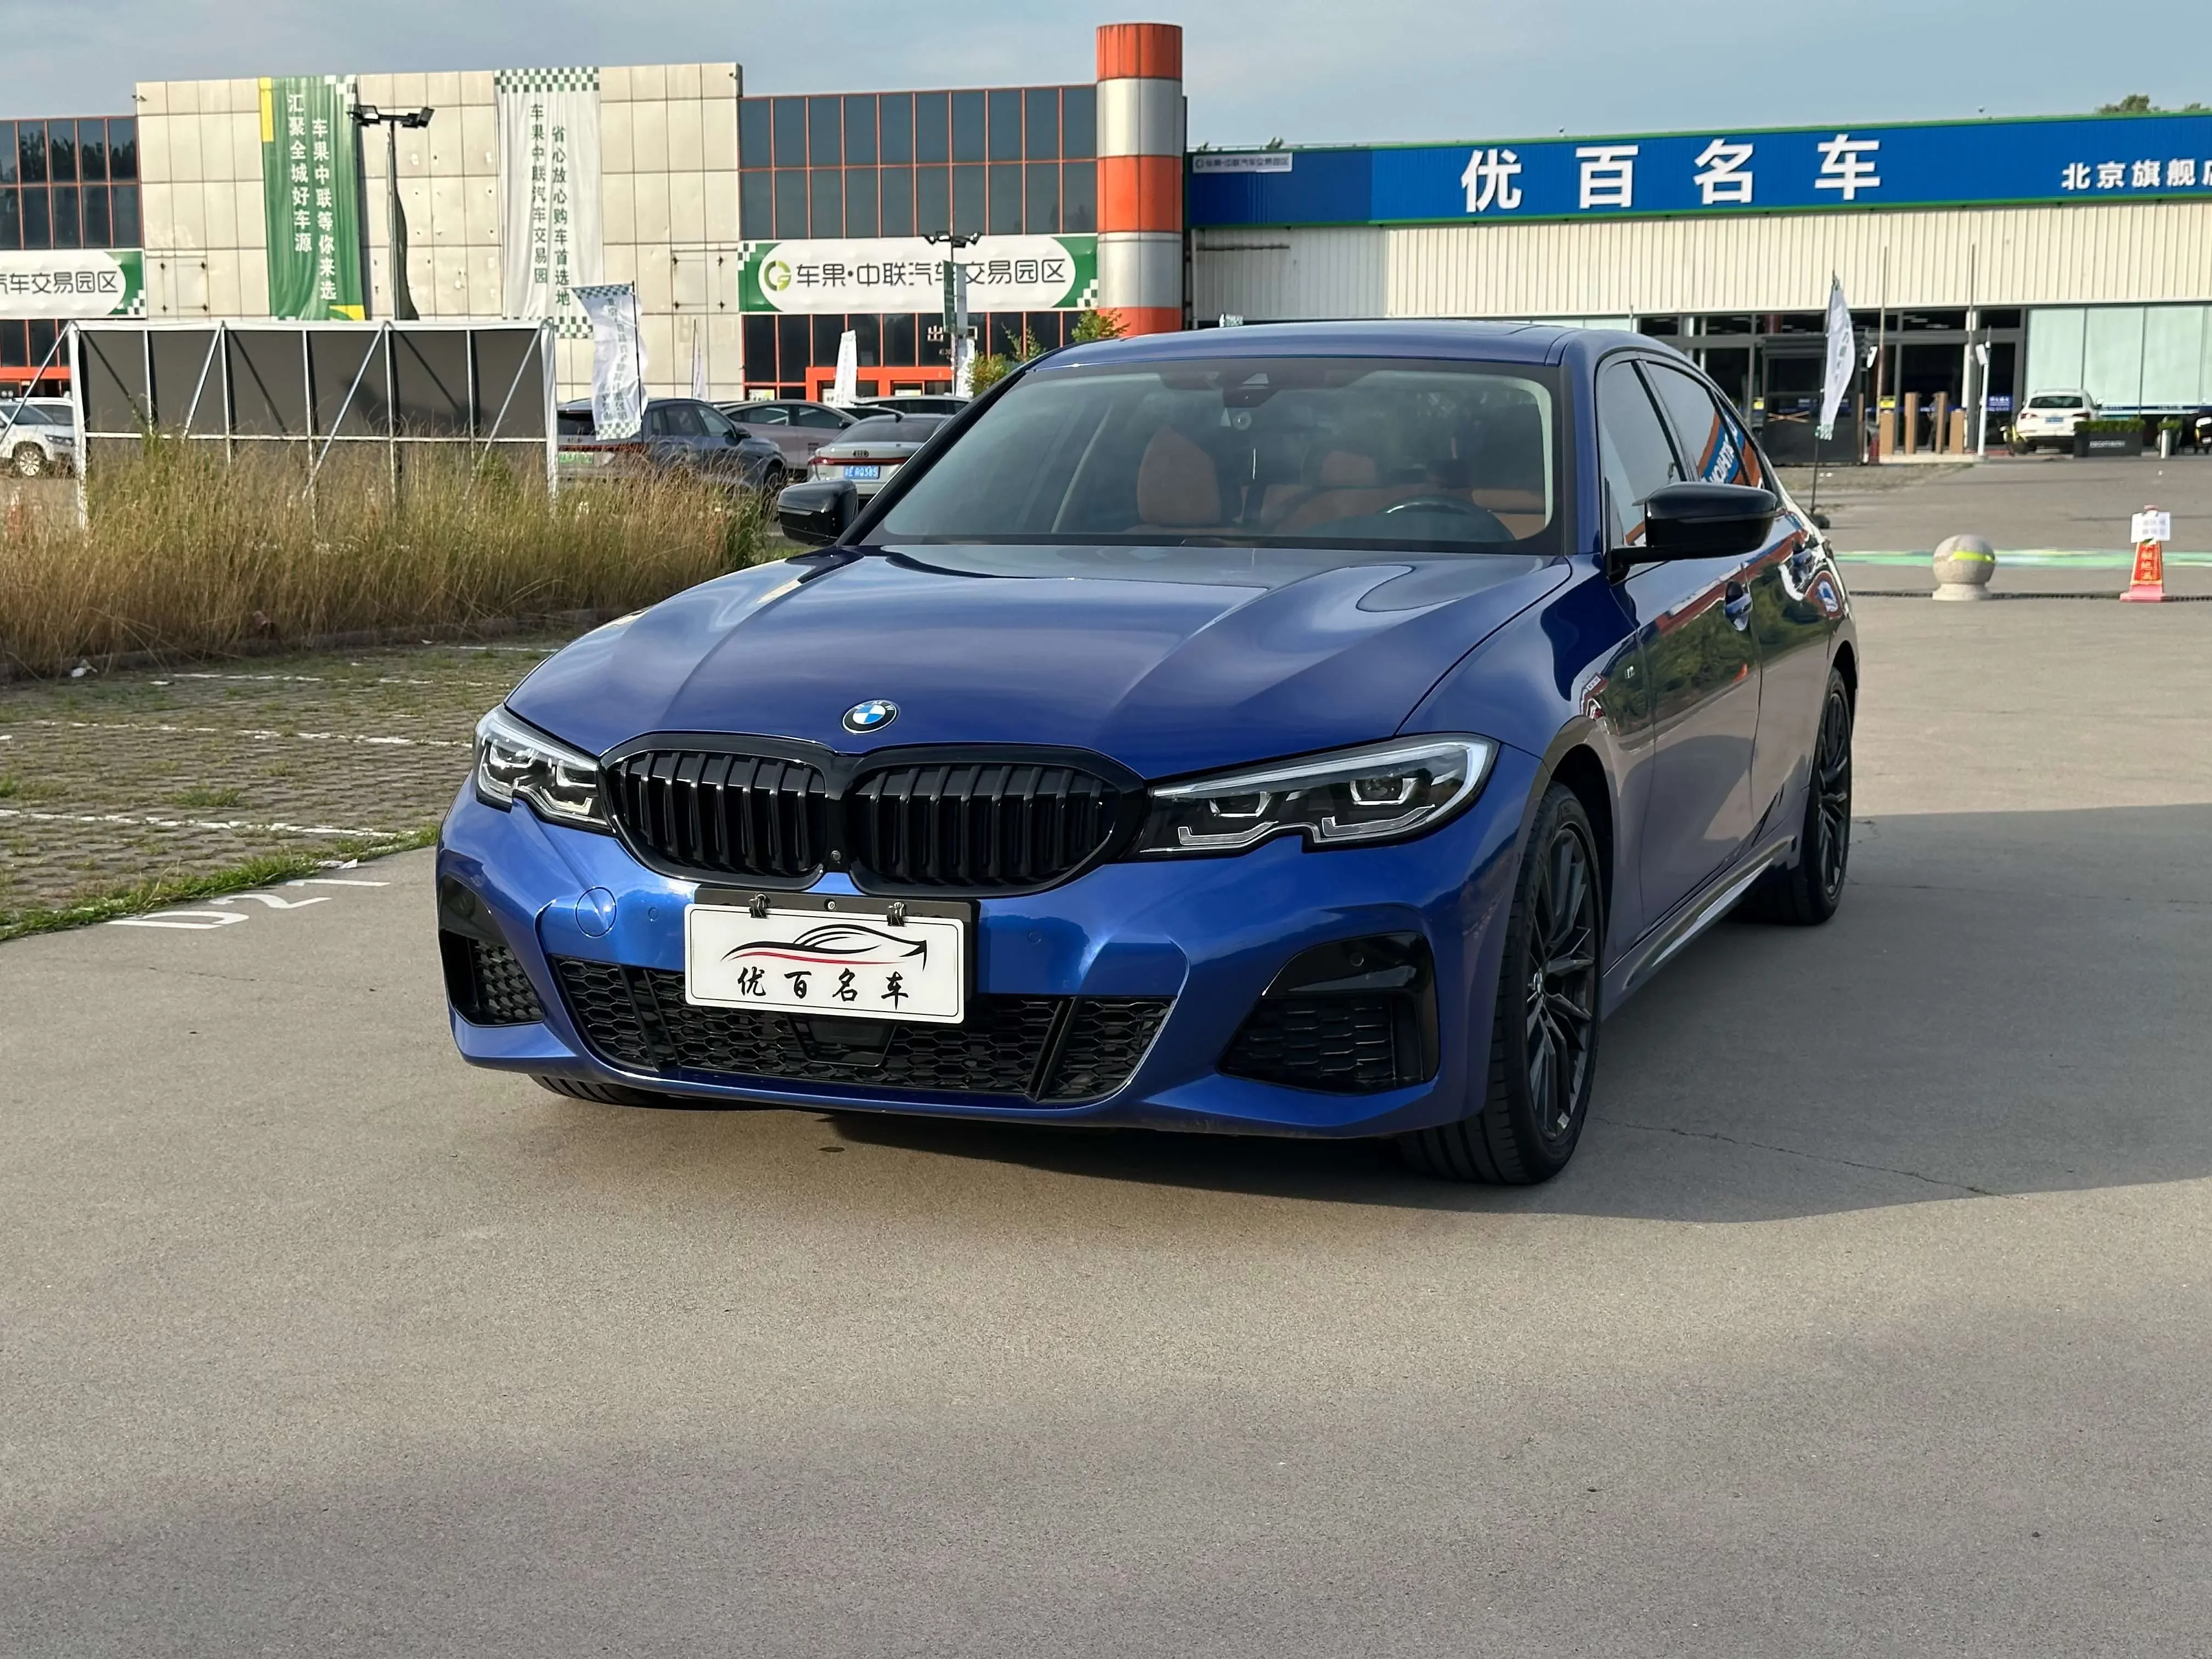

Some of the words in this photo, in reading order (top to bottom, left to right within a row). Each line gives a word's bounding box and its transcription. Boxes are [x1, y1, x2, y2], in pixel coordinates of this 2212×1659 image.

[288, 94, 312, 252] 汇聚全城好车源
[312, 119, 337, 300] 车果中联等你来选
[531, 104, 548, 284] 车果中联汽车交易园
[552, 126, 570, 306] 省心放心购车首选地
[1462, 134, 1881, 213] 优百名车
[738, 966, 909, 1010] 优百名车
